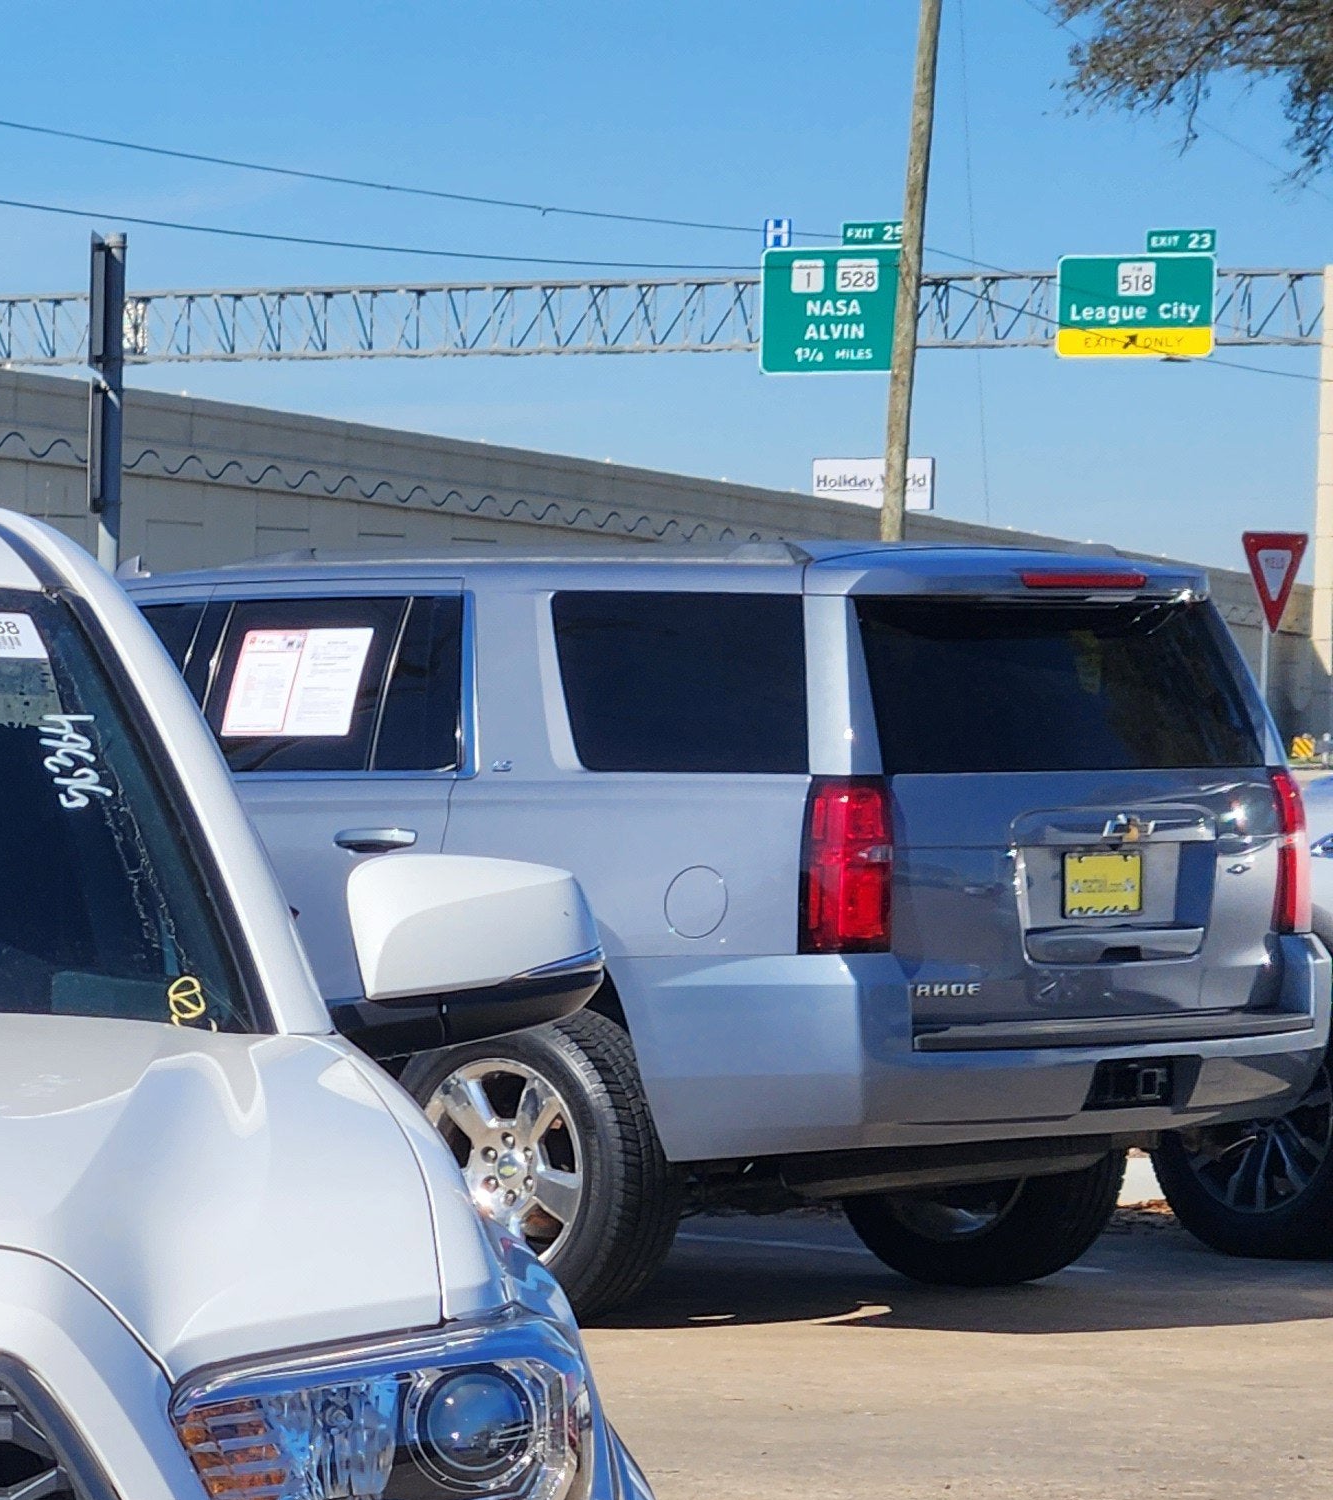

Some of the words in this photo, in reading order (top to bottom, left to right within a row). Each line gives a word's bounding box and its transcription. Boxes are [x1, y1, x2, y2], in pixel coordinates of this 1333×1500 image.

[846, 228, 874, 240] EXIT
[883, 226, 904, 241] 25
[1150, 235, 1180, 248] EXIT
[1188, 233, 1212, 249] 23
[805, 271, 811, 288] 1
[840, 271, 876, 288] 528
[1121, 275, 1153, 292] 518
[806, 299, 862, 316] NASA
[1070, 304, 1148, 325] League
[1158, 301, 1201, 323] City
[804, 323, 865, 340] ALVIN
[1084, 336, 1115, 348] EXIT
[1143, 336, 1184, 349] ONLY
[835, 349, 873, 360] MILES
[816, 474, 875, 488] Holiday
